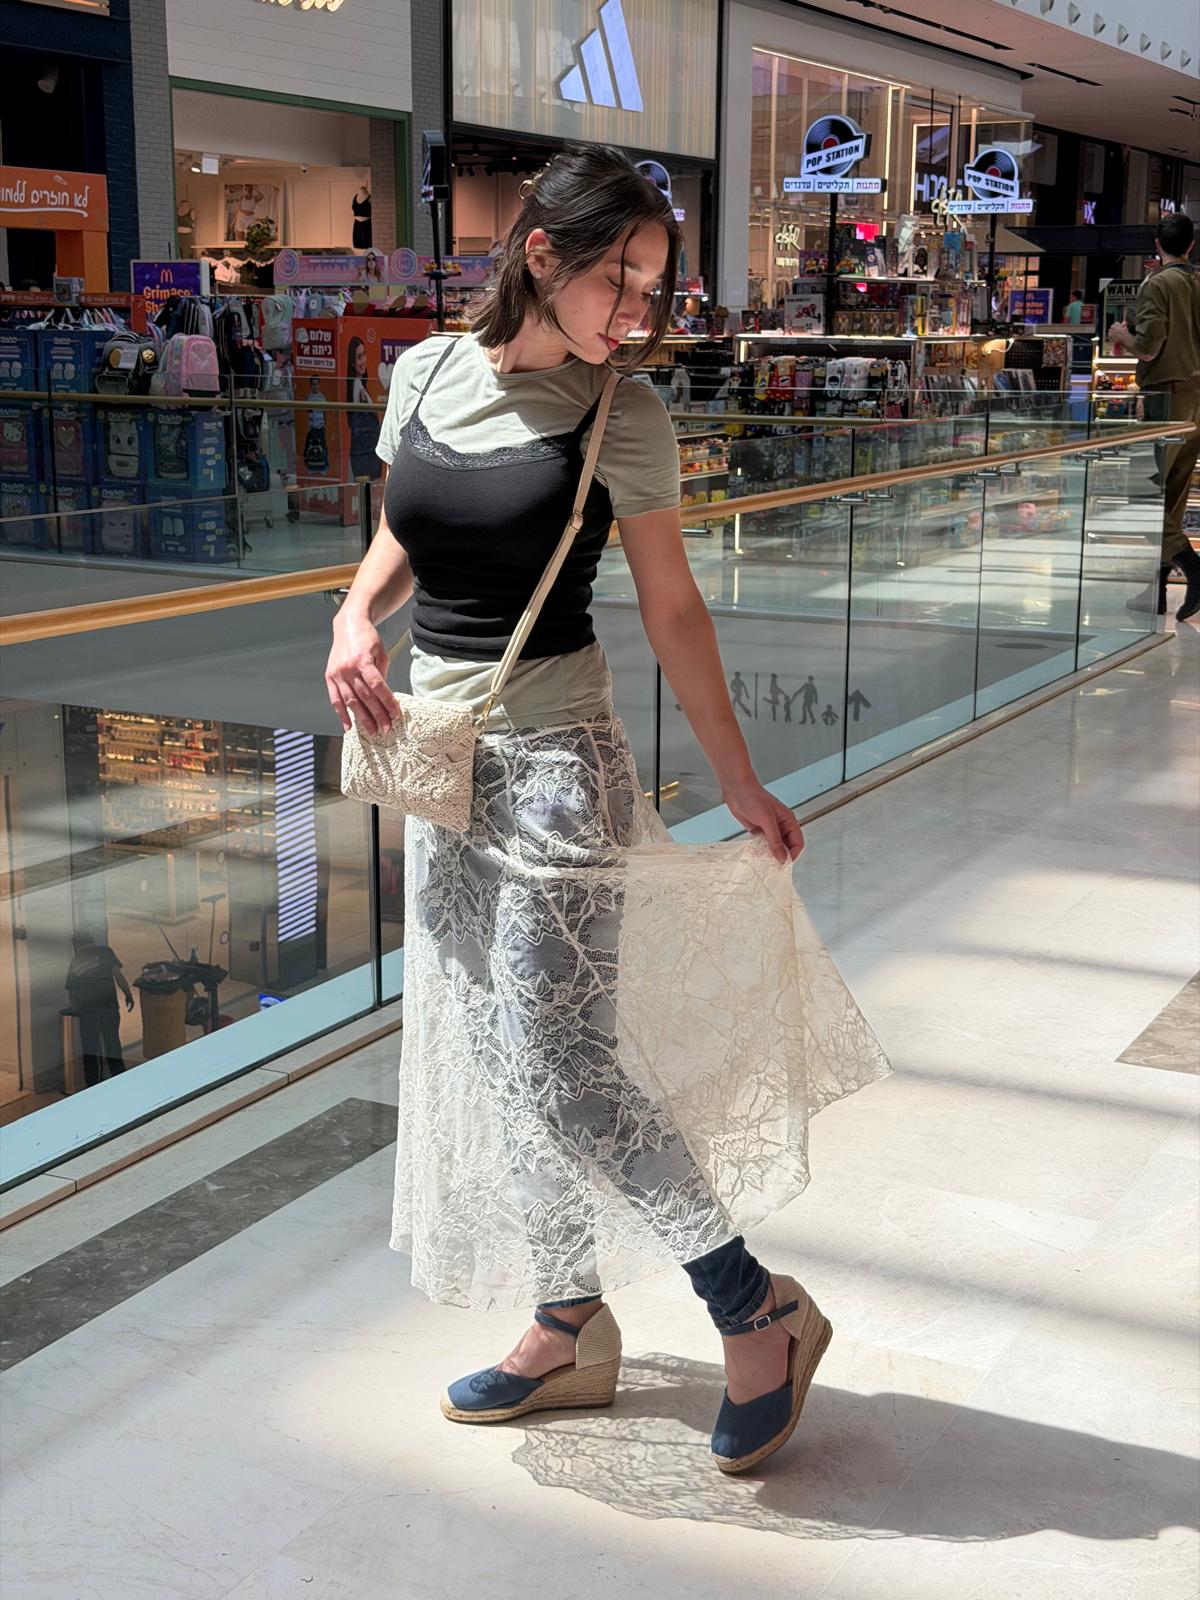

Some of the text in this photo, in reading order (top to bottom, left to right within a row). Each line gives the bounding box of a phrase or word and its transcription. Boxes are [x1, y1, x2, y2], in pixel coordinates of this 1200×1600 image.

[805, 143, 860, 169] POP STATION
[784, 179, 880, 190] מתנות תקליטים טרנדים
[967, 173, 1015, 193] POP STATION
[30, 190, 70, 206] חוזרים
[73, 185, 90, 208] לא
[1106, 285, 1139, 296] WANT
[309, 329, 332, 343] שלום
[311, 344, 333, 356] כיתה
